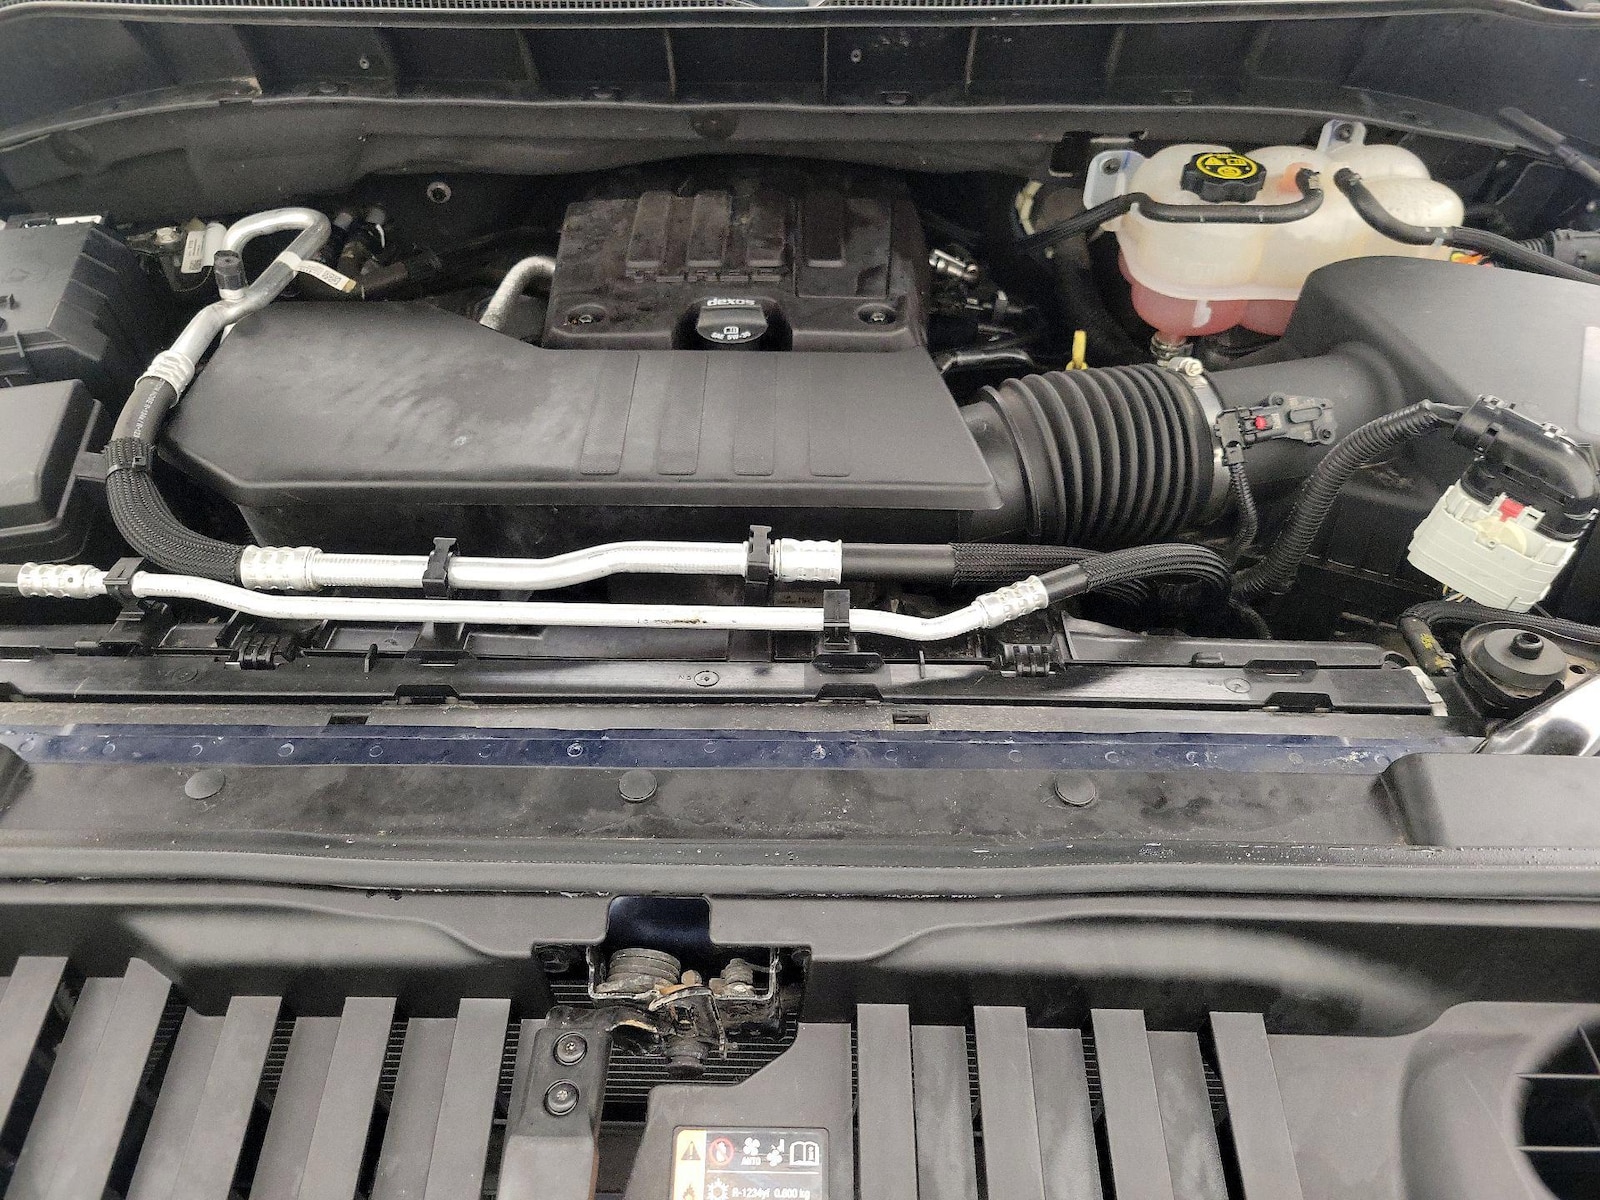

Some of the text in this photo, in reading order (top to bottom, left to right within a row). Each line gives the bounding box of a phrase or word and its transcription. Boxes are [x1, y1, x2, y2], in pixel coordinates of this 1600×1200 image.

[707, 297, 755, 306] dexos
[741, 1156, 761, 1165] AUTO
[800, 1188, 811, 1200] kg
